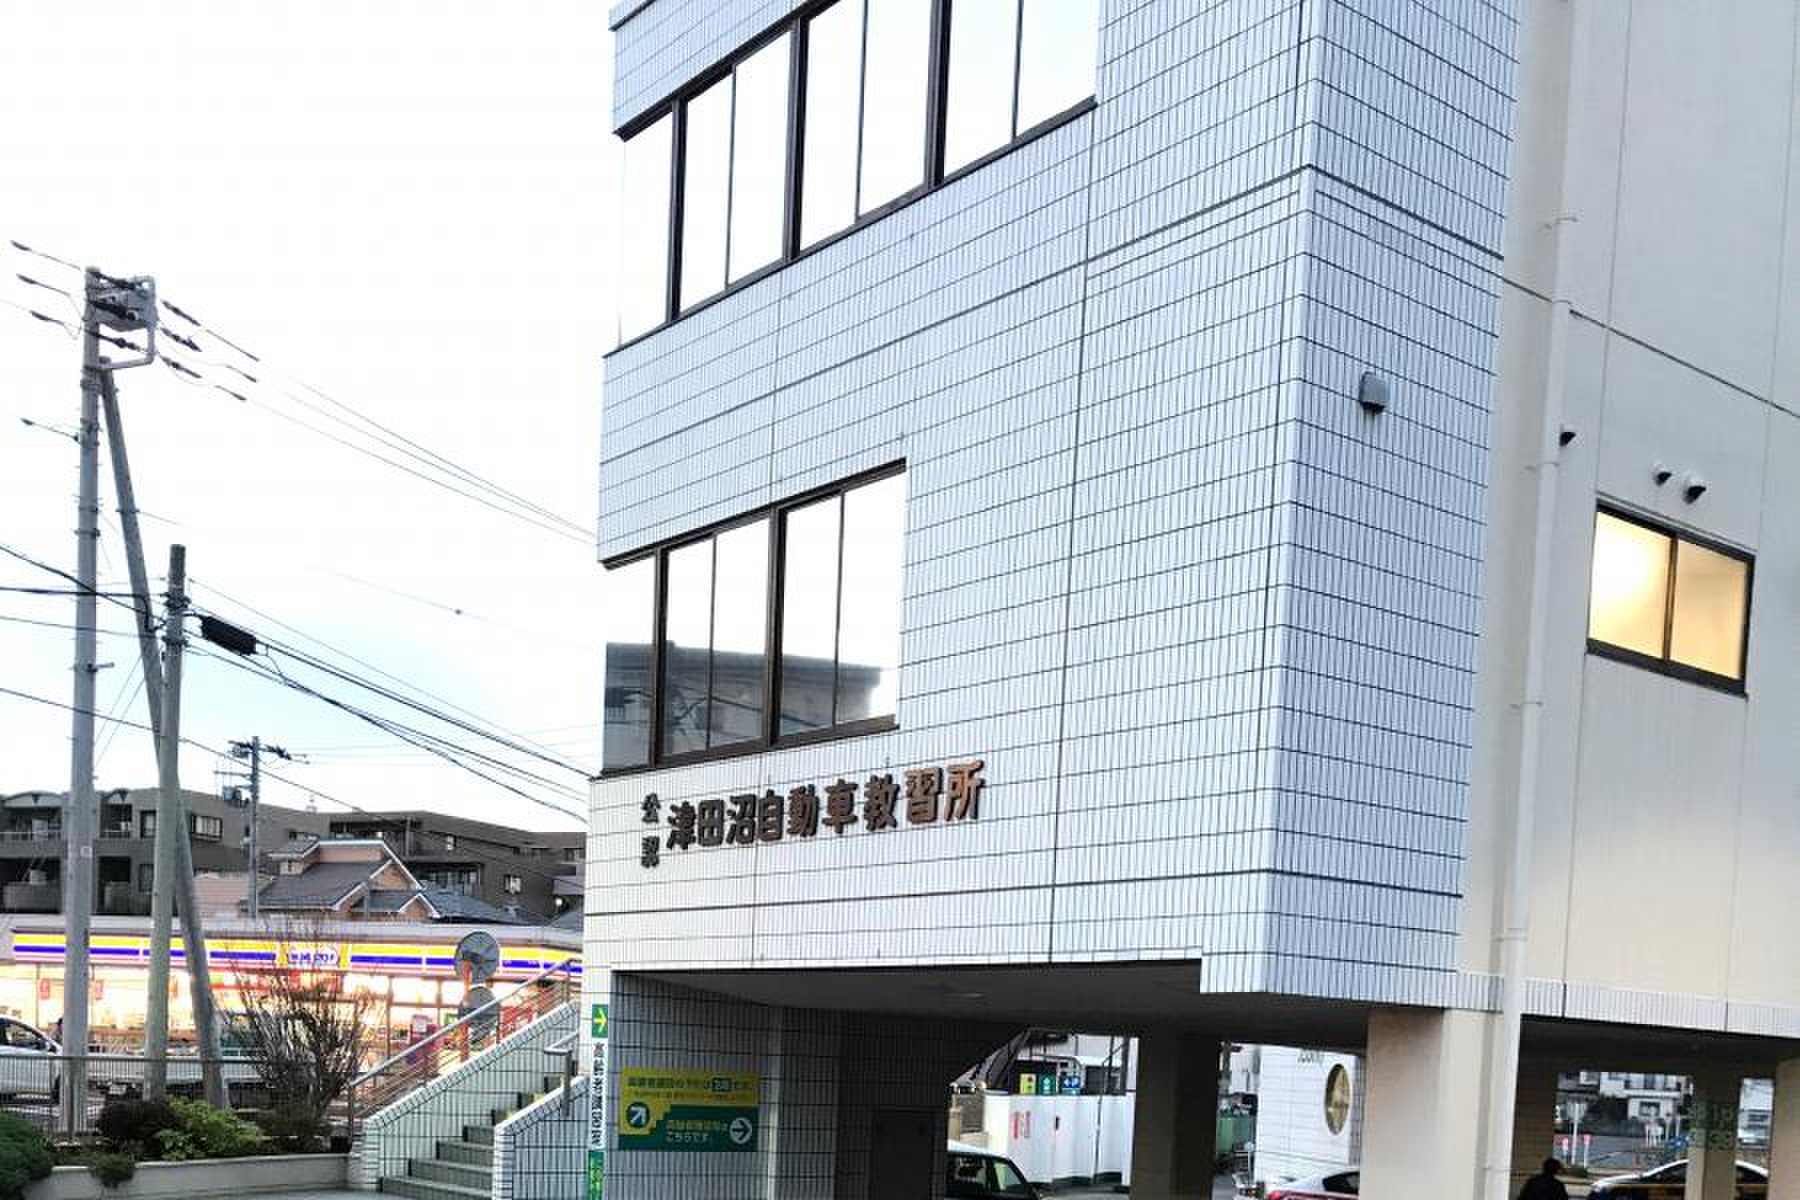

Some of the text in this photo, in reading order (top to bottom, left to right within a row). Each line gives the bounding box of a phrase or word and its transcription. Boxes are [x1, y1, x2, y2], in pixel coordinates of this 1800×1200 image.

[667, 761, 984, 850] 津田沼自動車教習所
